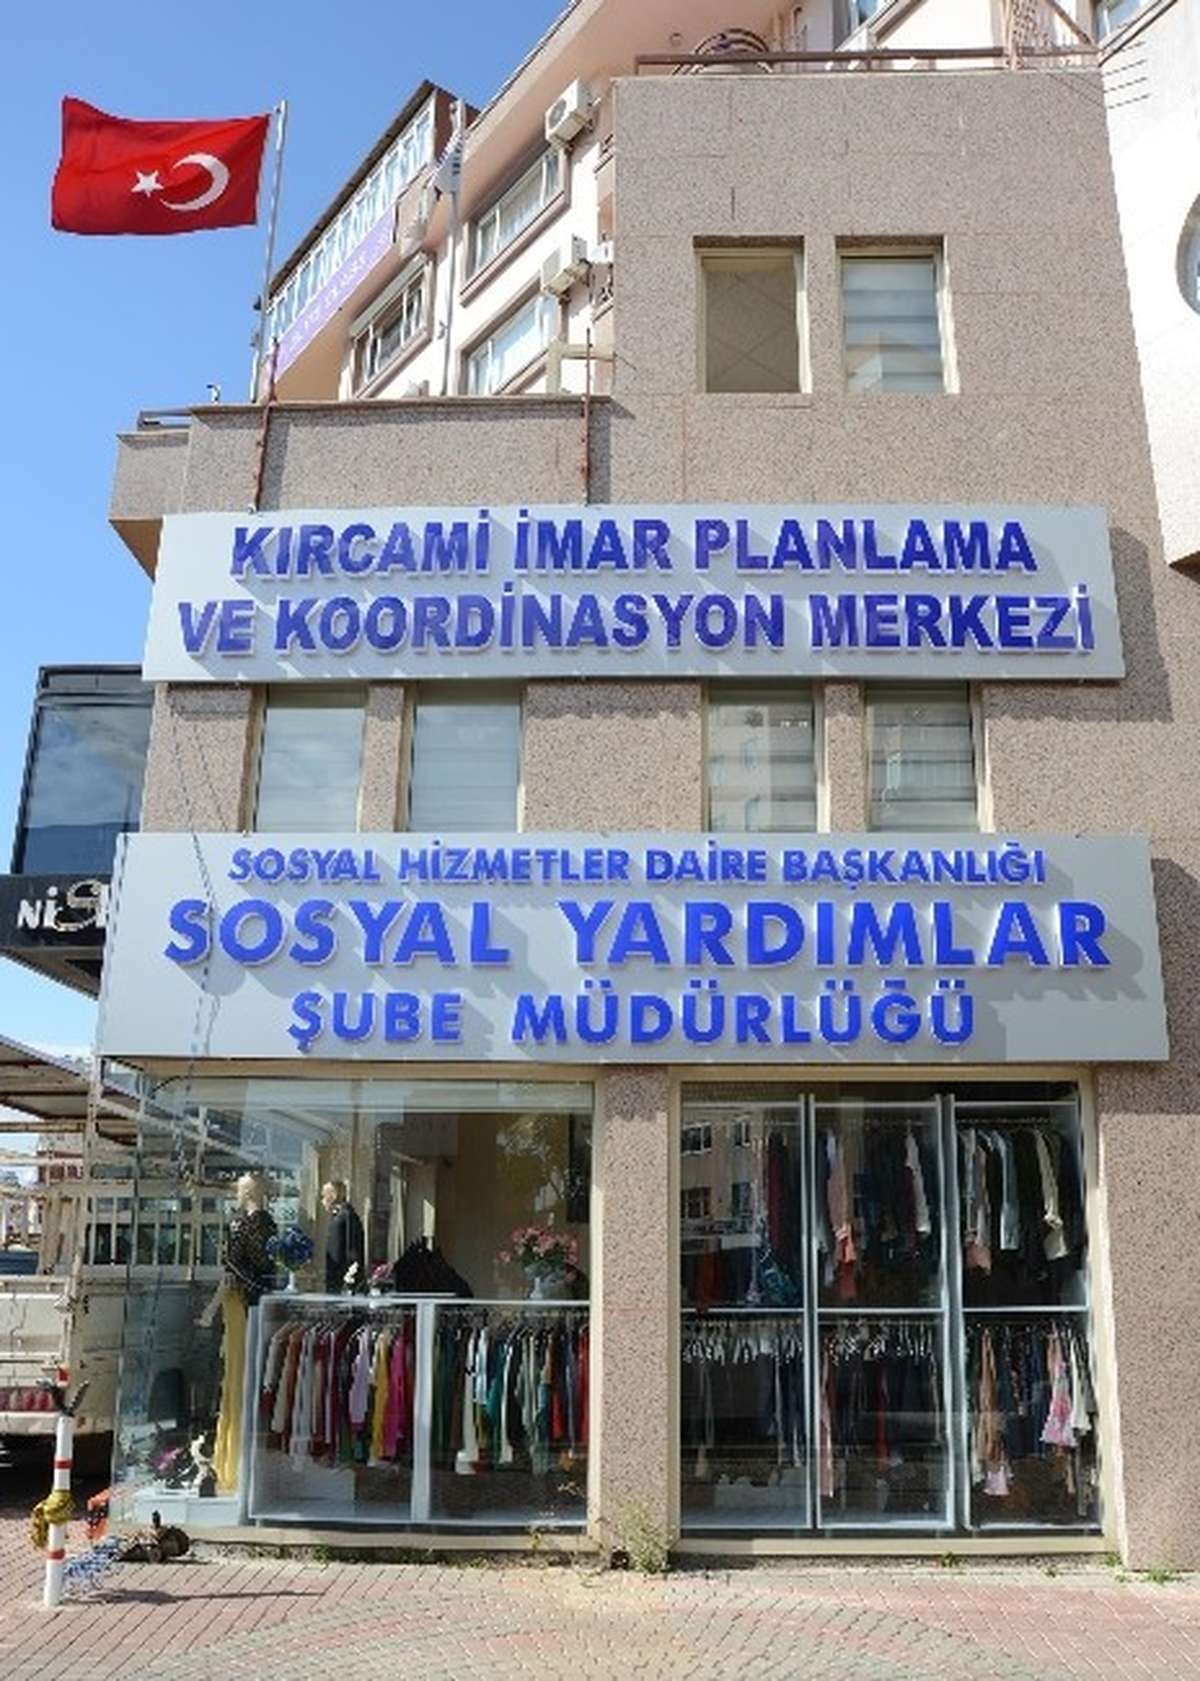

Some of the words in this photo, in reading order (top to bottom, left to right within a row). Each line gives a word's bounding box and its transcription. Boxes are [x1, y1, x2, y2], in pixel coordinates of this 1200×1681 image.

[230, 508, 492, 577] KIRCAMİ
[513, 509, 673, 572] İMAR
[695, 518, 1038, 573] PLANLAMA
[178, 599, 254, 654] VE
[273, 581, 786, 652] KOORDİNASYON
[810, 583, 1096, 652] MERKEZİ
[228, 847, 382, 884] SOSYAL
[397, 840, 631, 884] HİZMETLER
[645, 840, 768, 884] DAİRE
[782, 841, 1048, 892] BAŞKANLIĞI
[164, 897, 512, 967] SOSYAL
[557, 898, 1112, 968] YARDIMLAR
[287, 988, 464, 1054] ŞUBE
[510, 976, 976, 1045] MÜDÜRLÜĞÜ
